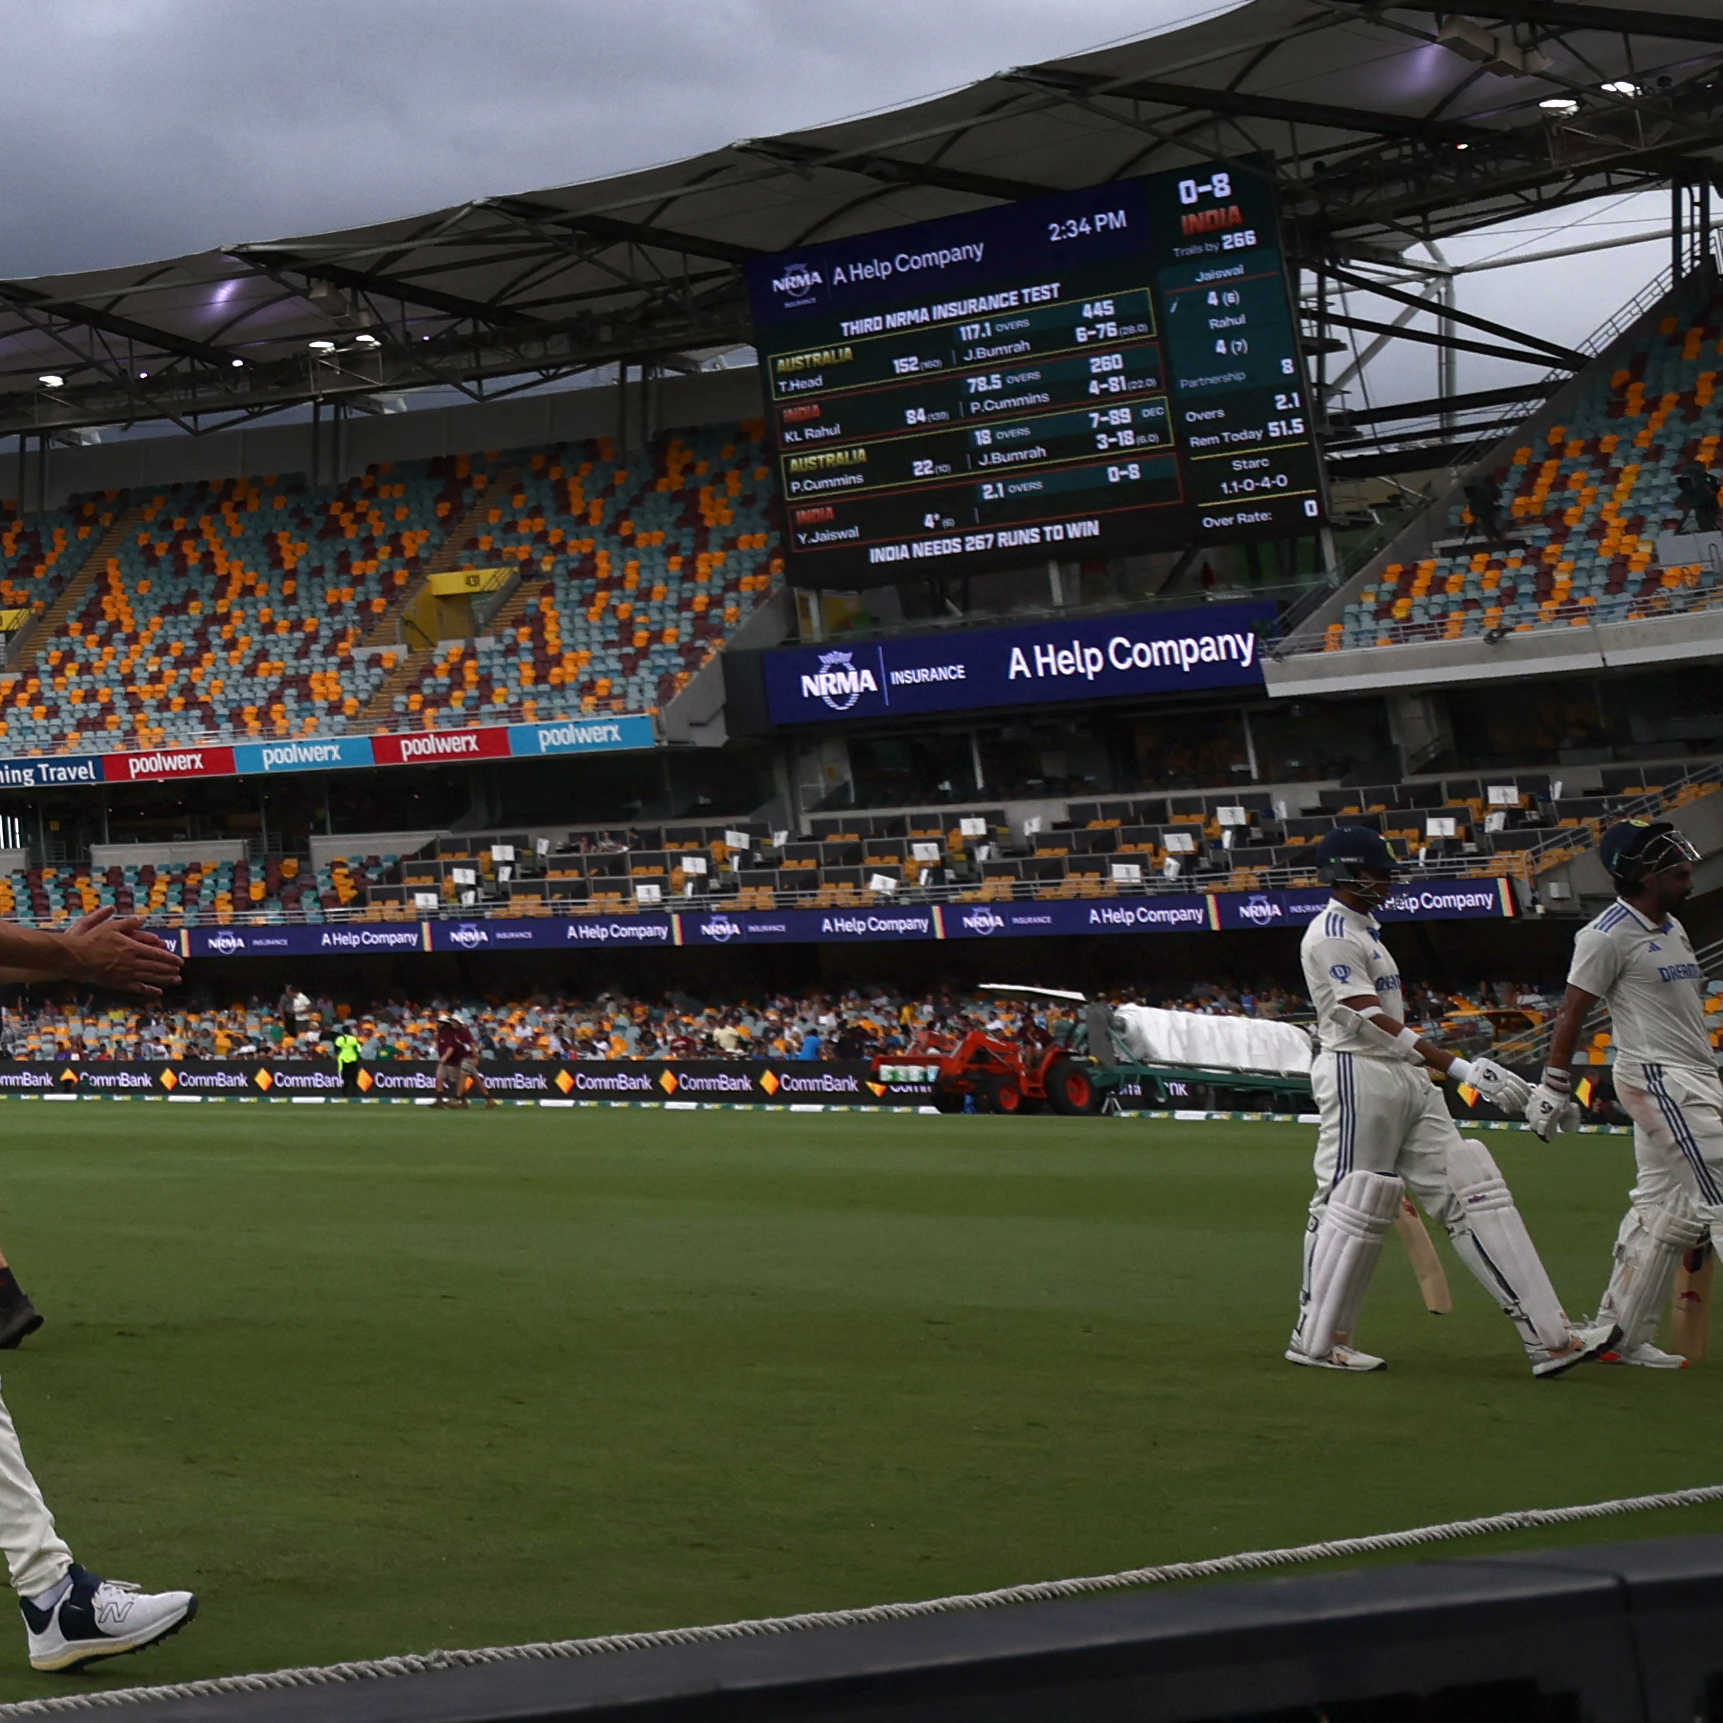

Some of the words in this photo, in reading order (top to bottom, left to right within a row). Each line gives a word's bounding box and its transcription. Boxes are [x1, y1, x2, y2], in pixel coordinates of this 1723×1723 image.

[1178, 172, 1232, 205] 0-8
[1048, 217, 1091, 241] 2:34
[1094, 210, 1127, 232] PM
[1181, 205, 1245, 235] INDIA
[1173, 245, 1204, 258] Trails
[1205, 242, 1220, 253] by
[1221, 230, 1257, 250] 266
[833, 267, 847, 286] A
[850, 259, 892, 281] Help
[895, 243, 984, 273] Company
[1195, 264, 1245, 283] Jaiswal
[772, 272, 823, 292] NRMA
[1207, 291, 1219, 306] 4
[841, 316, 884, 337] THIRD
[886, 308, 930, 329] NRMA
[932, 290, 1020, 321] INSURANCE
[1022, 283, 1060, 304] TEST
[1082, 300, 1114, 319] 445
[959, 323, 992, 342] 117.1
[996, 319, 1030, 332] OVERS
[1209, 314, 1246, 330] Rahul
[963, 340, 1031, 362] J.Bumrah
[1216, 339, 1227, 354] 4
[777, 347, 853, 374] AUSTRALIA
[1090, 353, 1123, 374] 260
[778, 375, 823, 393] T.Head
[892, 356, 919, 374] 152
[967, 374, 1002, 393] 78.5
[1006, 371, 1041, 384] OVERS
[1180, 372, 1246, 389] Partnership
[970, 392, 1050, 413] P.Cummins
[1141, 406, 1164, 418] DEC
[1185, 409, 1225, 422] Overs
[1274, 392, 1300, 410] 2.1
[784, 431, 803, 443] KL
[805, 424, 841, 440] Rahul
[996, 427, 1030, 440] OVERS
[1190, 434, 1220, 448] Rem
[1221, 429, 1263, 443] Today
[1267, 418, 1304, 437] 51.5
[790, 448, 867, 473] AUSTRALIA
[978, 445, 1047, 466] J.Bumrah
[1232, 458, 1270, 471] Starc
[791, 473, 864, 493] P.Cummins
[913, 459, 934, 477] 22
[982, 482, 1004, 500] 2.1
[1008, 481, 1043, 493] OVERS
[1203, 515, 1234, 528] Over
[1238, 512, 1272, 525] Rate:
[1304, 499, 1318, 517] 0
[797, 526, 860, 545] Y.Jaiswal
[869, 544, 910, 564] INDIA
[912, 537, 962, 559] NEEDS
[965, 533, 994, 552] 267
[996, 527, 1041, 548] RUNS
[1043, 524, 1063, 541] TO
[1067, 520, 1100, 539] WIN
[1008, 647, 1030, 680] A
[1034, 642, 1104, 681] Help
[1108, 632, 1255, 672] Company
[801, 670, 878, 698] NRMA
[890, 664, 966, 686] INSURANCE
[400, 733, 479, 762] poolwerx
[538, 723, 621, 752] poolwerx
[129, 751, 204, 780] poolwerx
[262, 743, 341, 771] poolwerx
[38, 761, 96, 783] Travel
[823, 920, 833, 933] A
[835, 918, 866, 935] Help
[868, 917, 928, 934] Company
[1089, 909, 1101, 924] A
[1102, 908, 1134, 926] Help
[1136, 907, 1204, 926] Company
[321, 933, 332, 946] A
[334, 932, 360, 948] Help
[362, 930, 418, 947] Company
[568, 926, 577, 939] A
[579, 924, 608, 941] Help
[610, 924, 668, 941] Company
[179, 1072, 248, 1088] CommBank
[575, 1072, 653, 1091] CommBank
[679, 1073, 753, 1091] CommBank
[780, 1075, 859, 1093] CommBank
